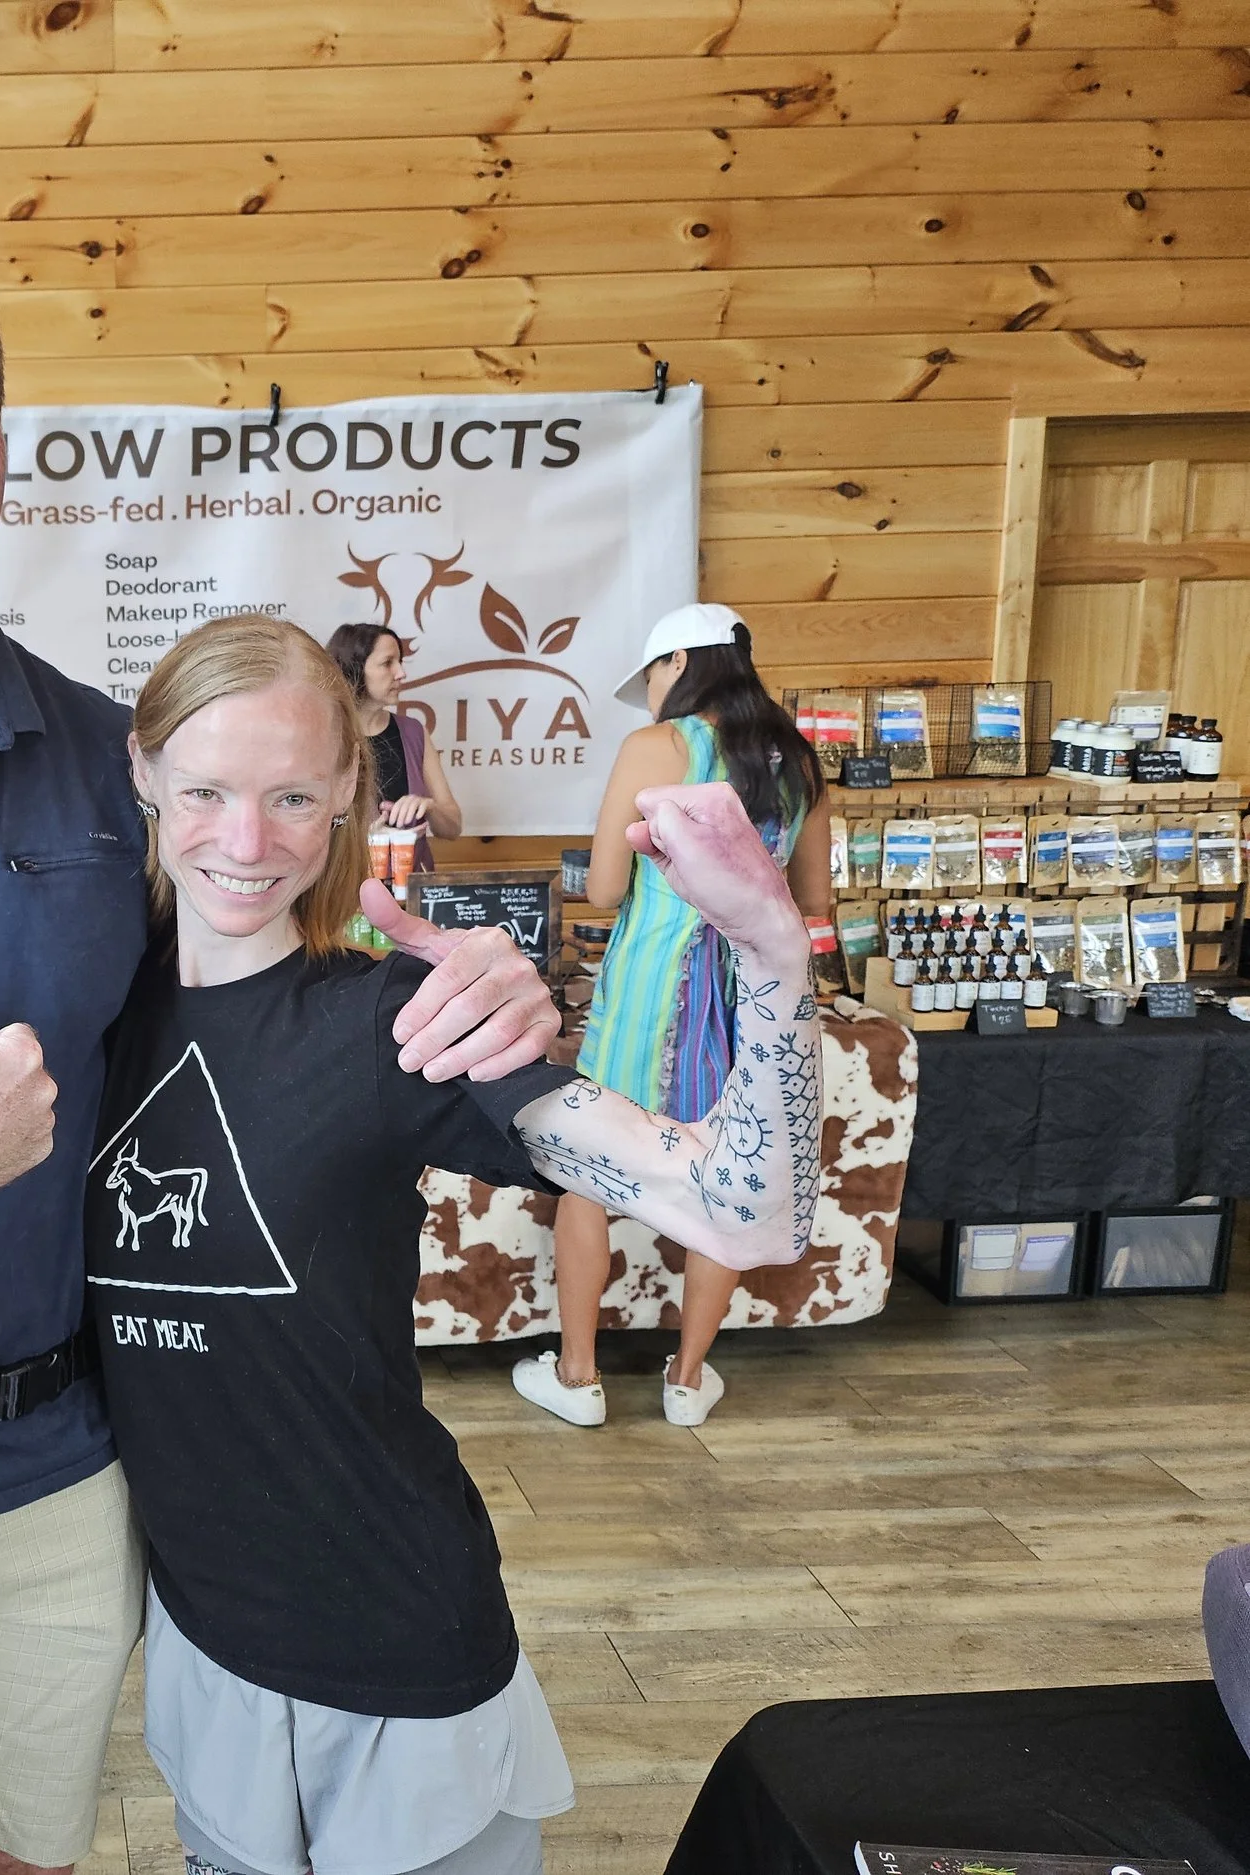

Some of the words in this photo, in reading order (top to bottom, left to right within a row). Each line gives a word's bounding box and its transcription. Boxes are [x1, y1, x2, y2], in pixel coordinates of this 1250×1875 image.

[191, 418, 582, 476] PRODUCTS
[0, 495, 163, 527] Grass-fed
[186, 489, 291, 519] Herbal
[312, 486, 442, 521] Organic
[105, 552, 157, 572] Soap
[105, 576, 218, 596] Deodorant
[106, 605, 188, 625] Makeup
[111, 1314, 148, 1348] EAT
[153, 1318, 209, 1353] MEAT.
